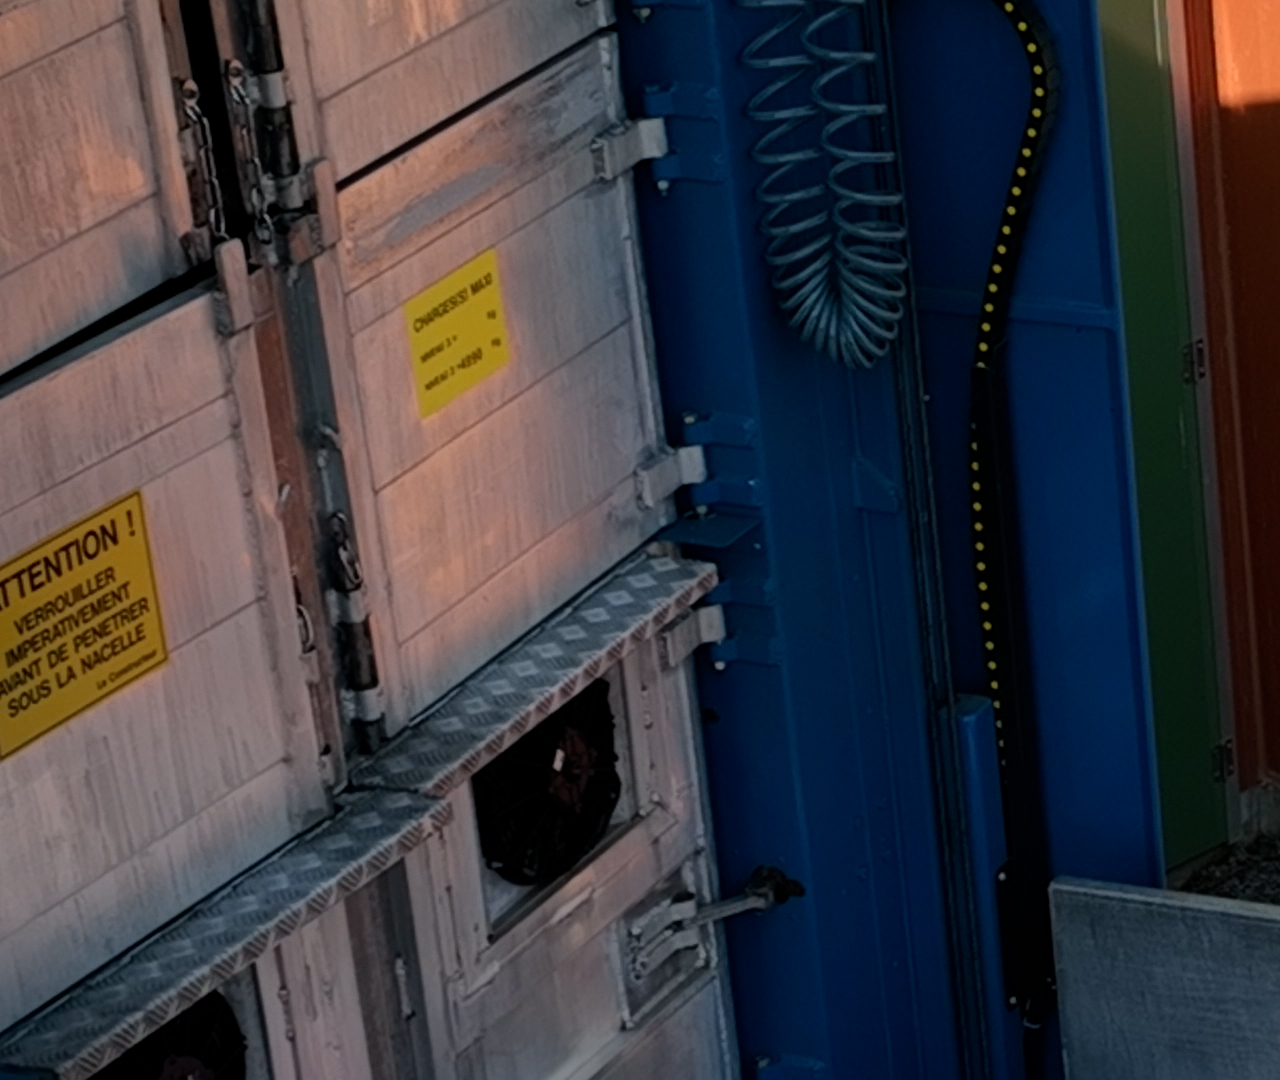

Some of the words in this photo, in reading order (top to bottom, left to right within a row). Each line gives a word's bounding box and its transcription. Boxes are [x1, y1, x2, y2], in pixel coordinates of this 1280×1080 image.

[0, 519, 119, 611] TTENTION
[13, 566, 116, 636] VERROUILLER
[0, 657, 42, 700] AVANT
[47, 643, 69, 670] DE
[73, 597, 150, 655] PENETRER
[5, 581, 132, 668] IMPERATIVEMENT
[8, 679, 52, 718] SOUS
[56, 666, 77, 690] LA
[80, 622, 146, 675] NACELLE
